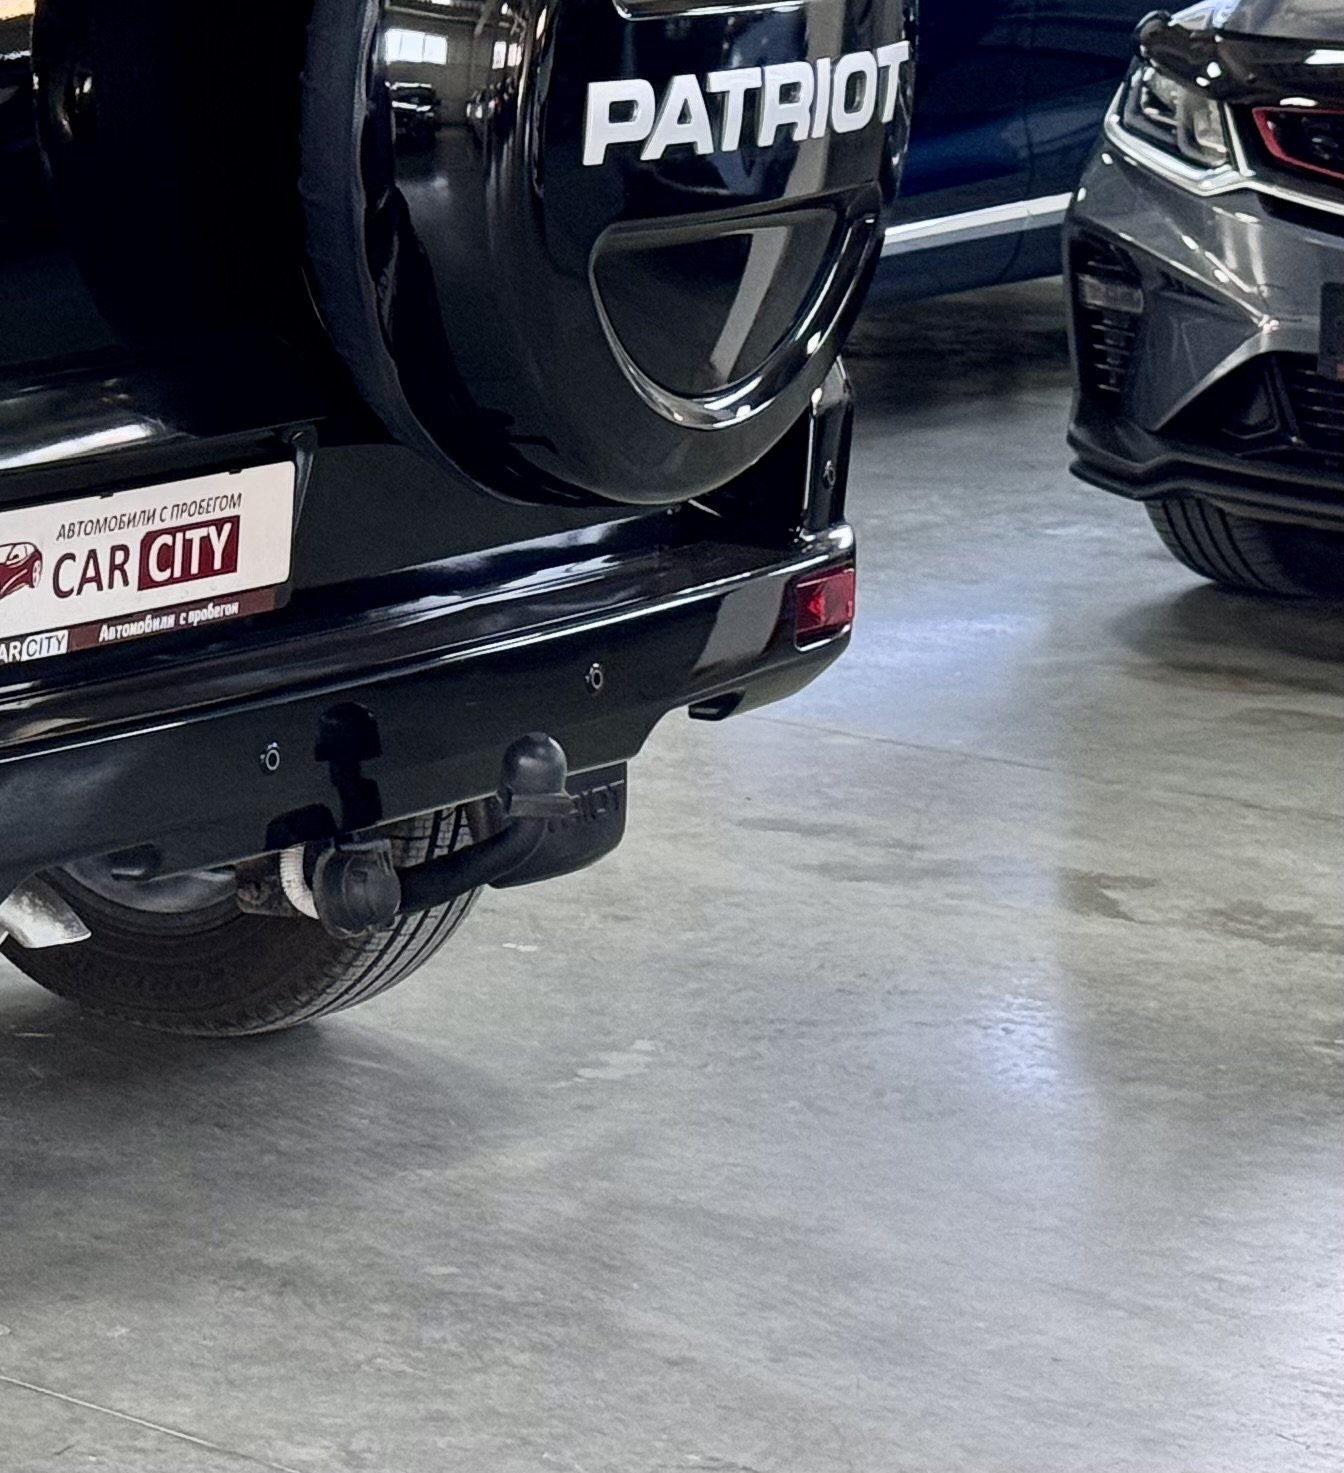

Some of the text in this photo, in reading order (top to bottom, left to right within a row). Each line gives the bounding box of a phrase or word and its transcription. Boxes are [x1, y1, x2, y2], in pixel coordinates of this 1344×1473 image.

[582, 40, 910, 166] PATRIOT
[56, 493, 243, 542] АВТОМОБИЛИ С ПРОБЕГОМ
[52, 522, 233, 599] CAR CITY
